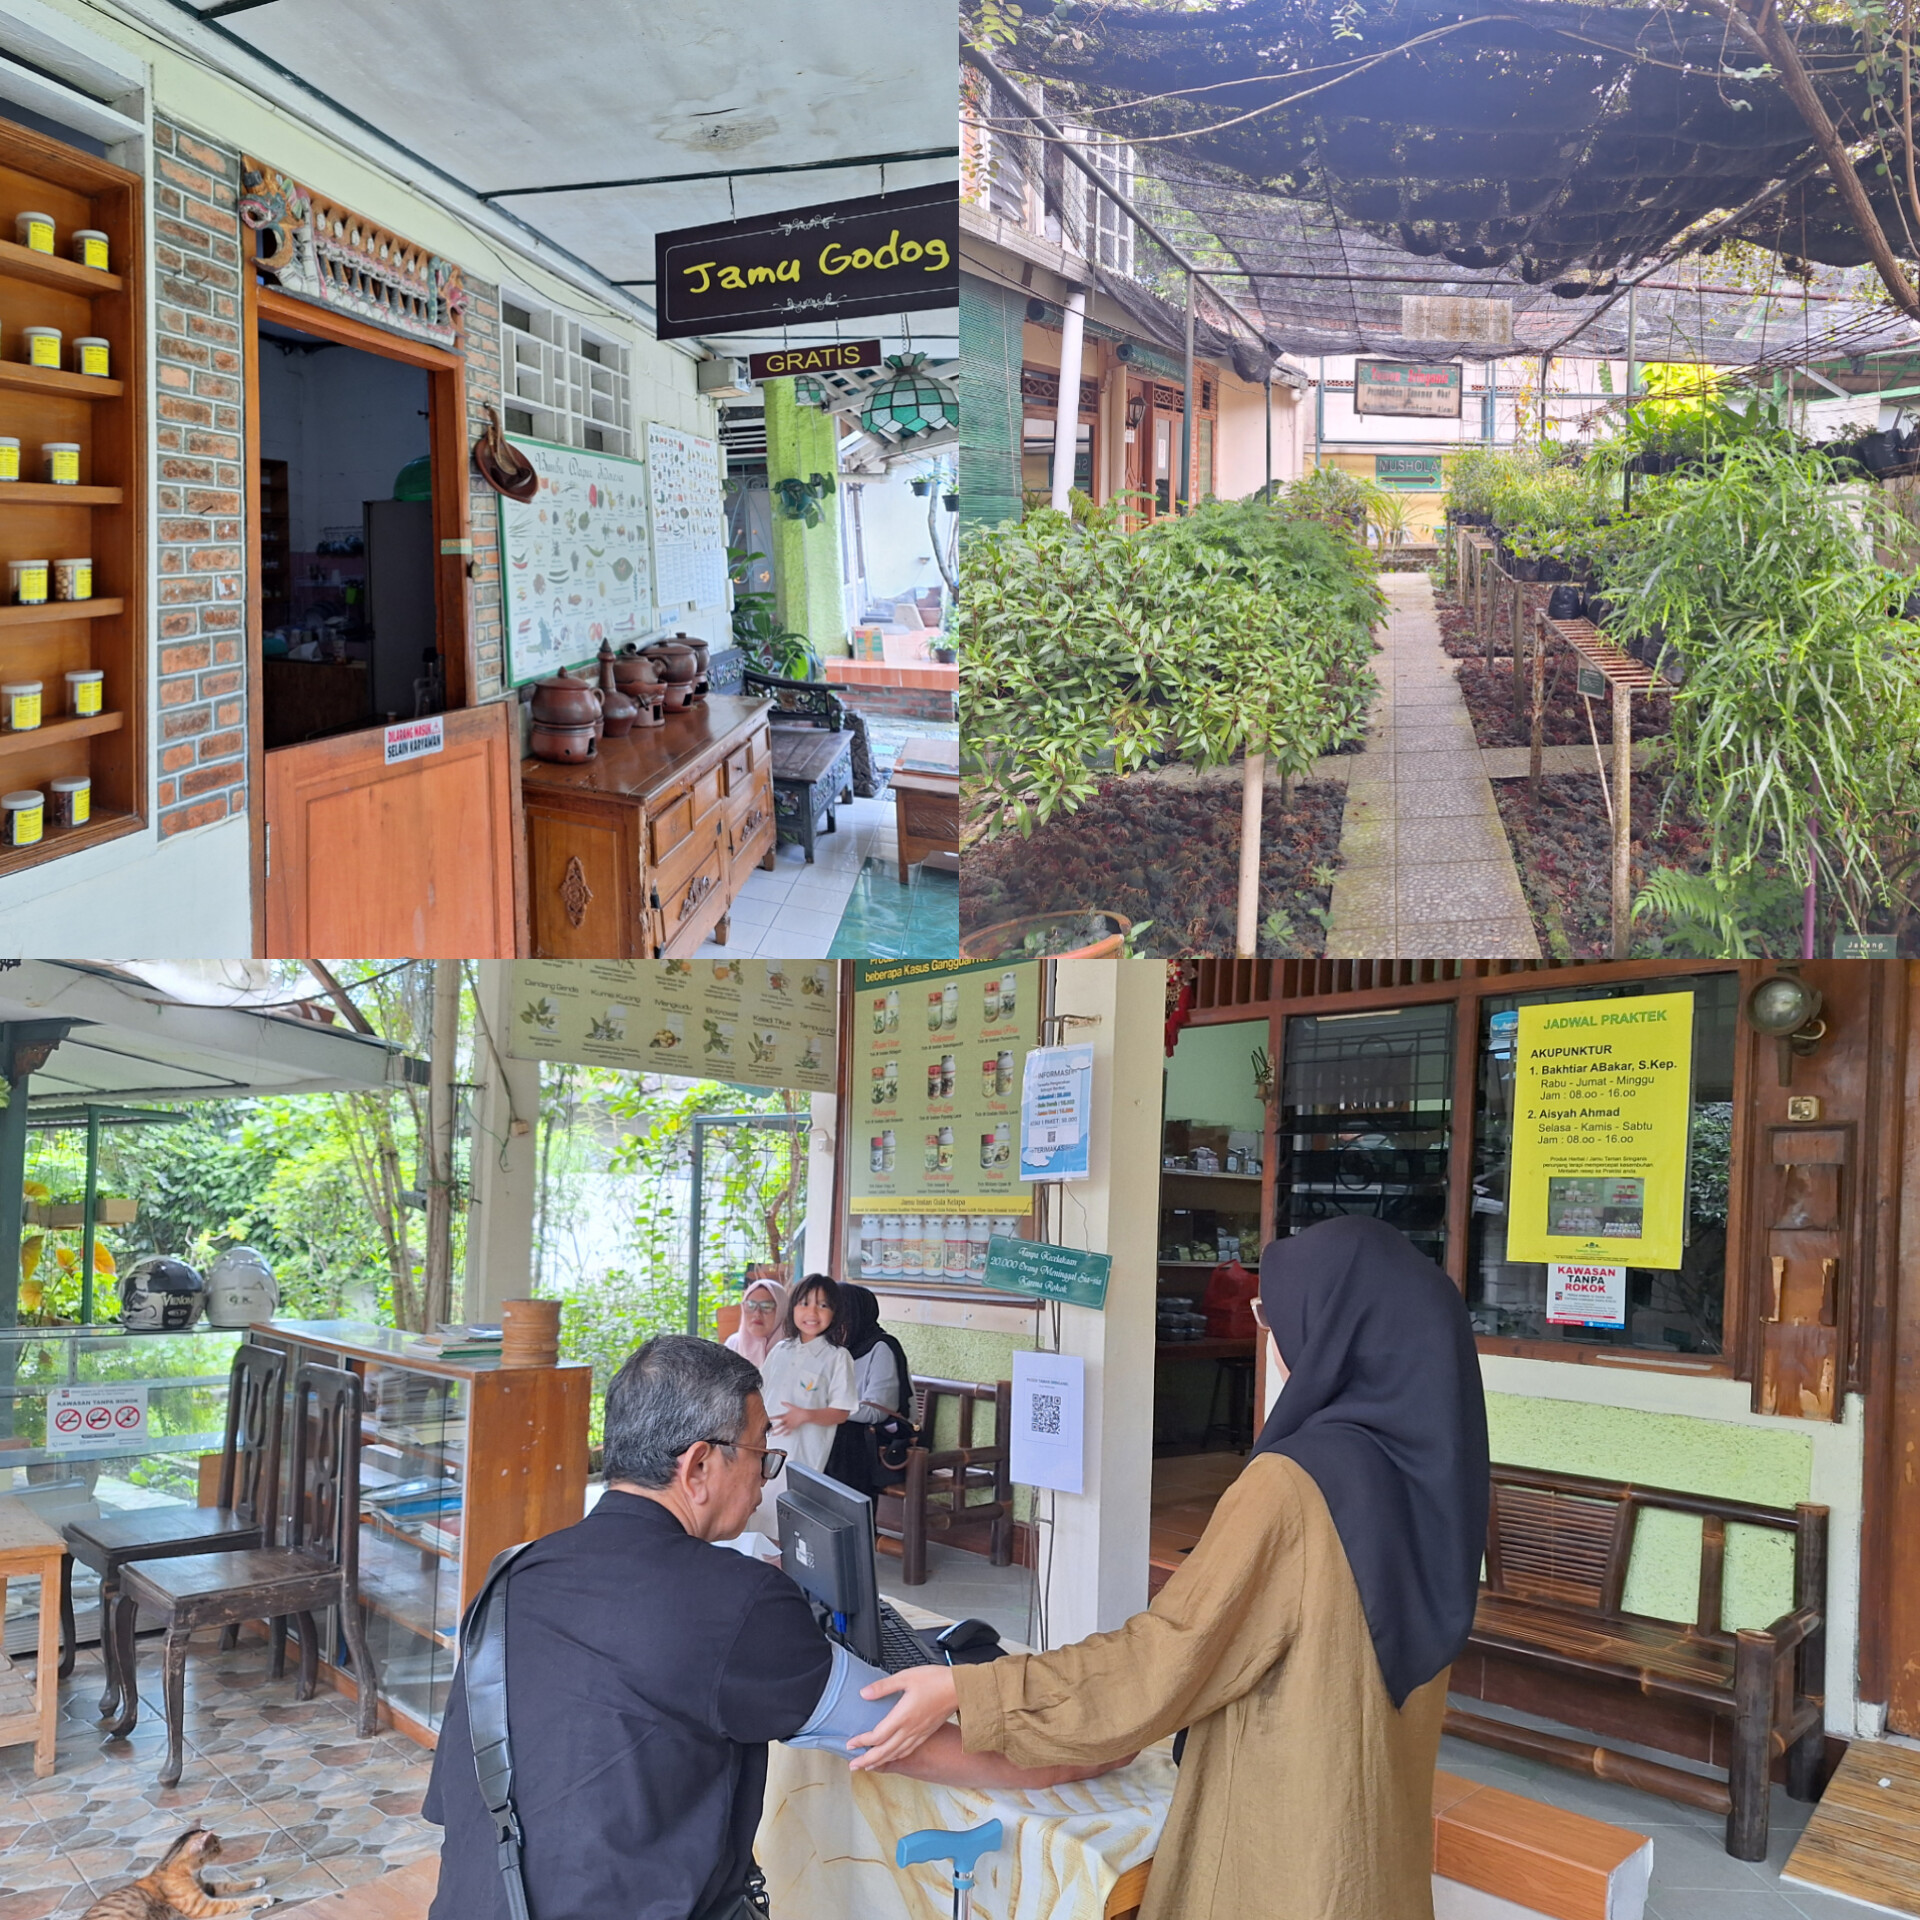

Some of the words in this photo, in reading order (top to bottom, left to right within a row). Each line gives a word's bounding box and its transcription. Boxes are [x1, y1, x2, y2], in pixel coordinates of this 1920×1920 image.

[683, 259, 800, 293] Jamu
[819, 230, 950, 275] Godog
[766, 346, 861, 373] GRATIS
[1379, 459, 1439, 473] MUSHOLA
[388, 727, 413, 743] DILARANG
[414, 723, 432, 738] MASUK
[388, 742, 409, 758] SELAIN
[410, 735, 441, 752] KARYAWAN
[865, 968, 903, 982] beberapa
[903, 963, 930, 976] Kasus
[931, 959, 974, 971] Gangguan
[1543, 1016, 1598, 1030] JADWAL
[1601, 1010, 1667, 1026] PRAKTEK
[1530, 1044, 1613, 1058] AKUPUNKTUR
[1038, 1068, 1071, 1079] INFORMASI
[1529, 1067, 1538, 1075] 1.
[1541, 1063, 1588, 1075] Bakhtiar
[1590, 1062, 1635, 1073] ABakar,
[1638, 1059, 1678, 1071] S.Kep.
[1541, 1079, 1567, 1088] Rabu
[1576, 1077, 1607, 1087] Jumat
[1616, 1075, 1655, 1086] Minggu
[1540, 1091, 1561, 1100] Jam
[1527, 1110, 1537, 1119] 2.
[1539, 1108, 1577, 1120] Aisyah
[1580, 1107, 1620, 1118] Ahmad
[1538, 1123, 1571, 1132] Selasa
[1581, 1122, 1612, 1132] Kamis
[1622, 1121, 1653, 1131] Sabtu
[1538, 1135, 1558, 1144] Jam
[947, 1199, 966, 1207] Kelapa
[1018, 1247, 1039, 1260] Tanpa
[990, 1256, 1018, 1269] 20.000
[1018, 1261, 1039, 1276] Orang
[1040, 1265, 1077, 1282] Meninggal
[1557, 1266, 1616, 1277] KAWASAN
[1044, 1280, 1067, 1293] Rokok
[1567, 1275, 1605, 1285] TANPA
[1565, 1283, 1606, 1293] ROKOK
